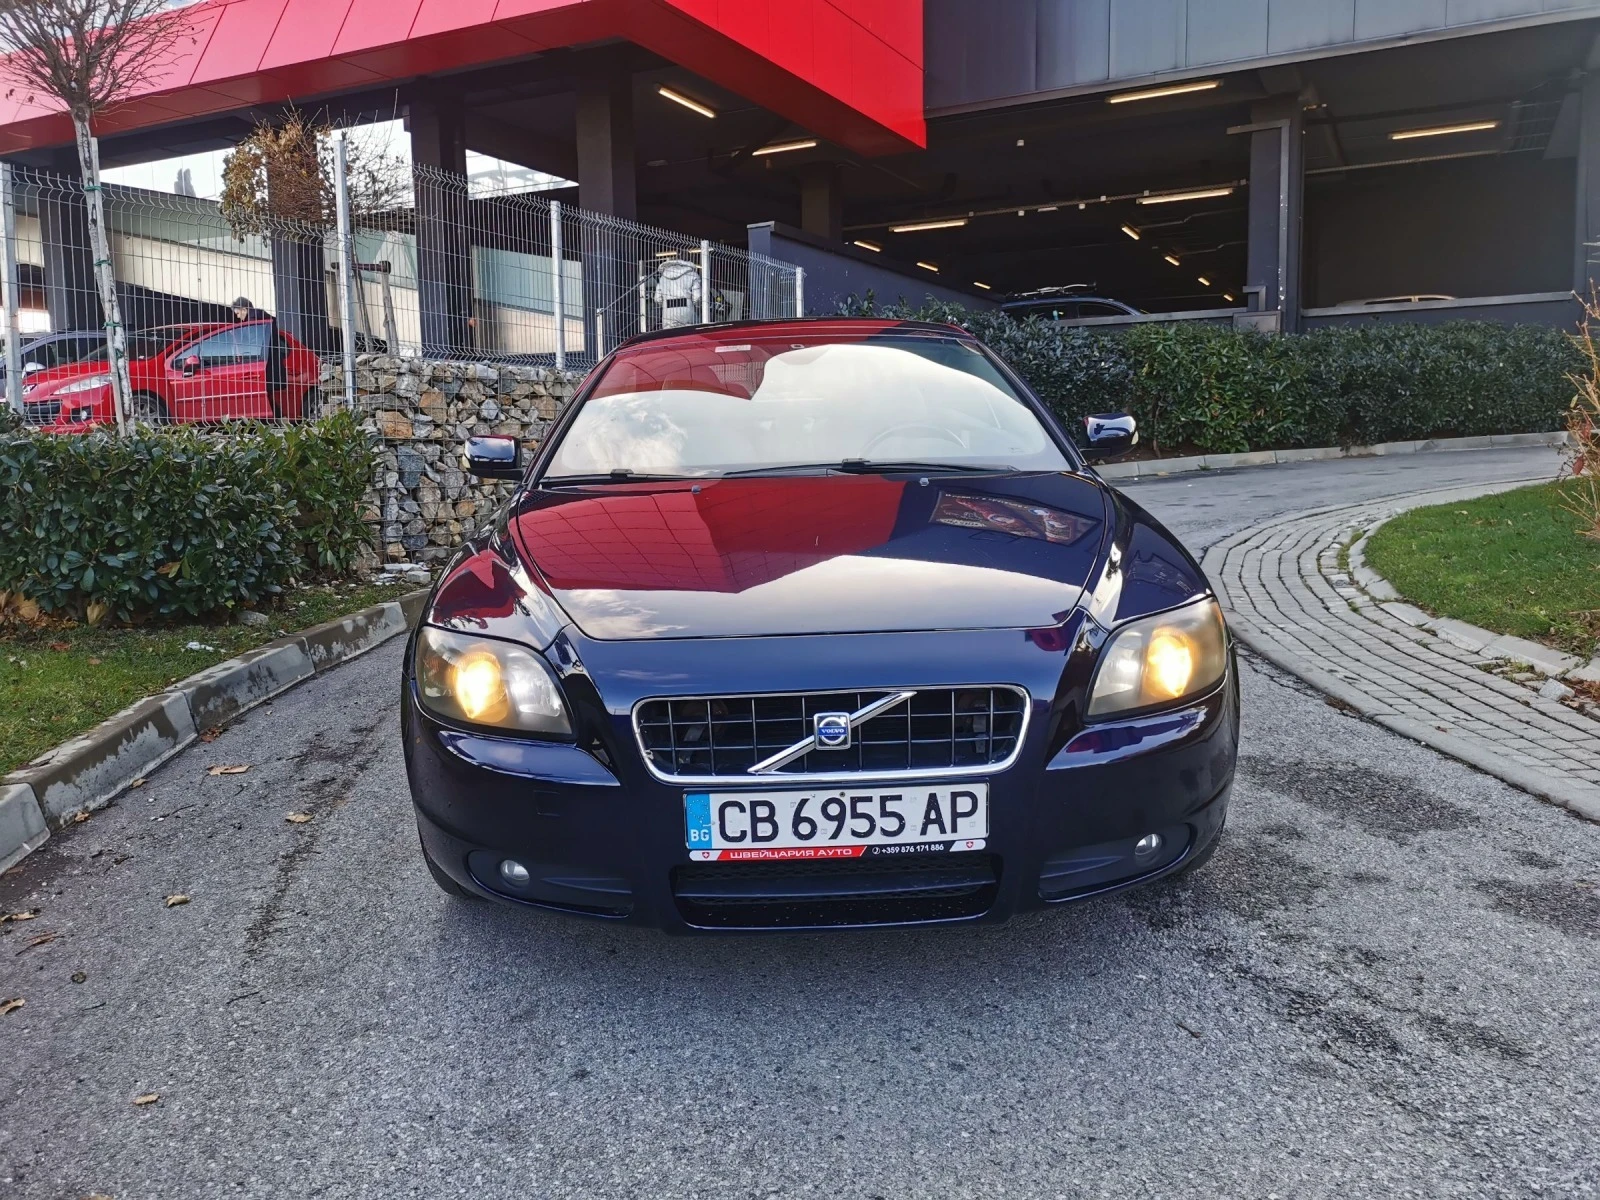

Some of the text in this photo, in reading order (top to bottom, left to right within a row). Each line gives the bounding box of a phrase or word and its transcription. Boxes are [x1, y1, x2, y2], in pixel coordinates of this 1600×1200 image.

[718, 790, 979, 843] CB 6955 AP
[690, 829, 710, 842] BG
[730, 848, 852, 859] ШВЕЙЦАРИЯ АУТО
[901, 845, 915, 853] 876
[917, 844, 929, 852] 171
